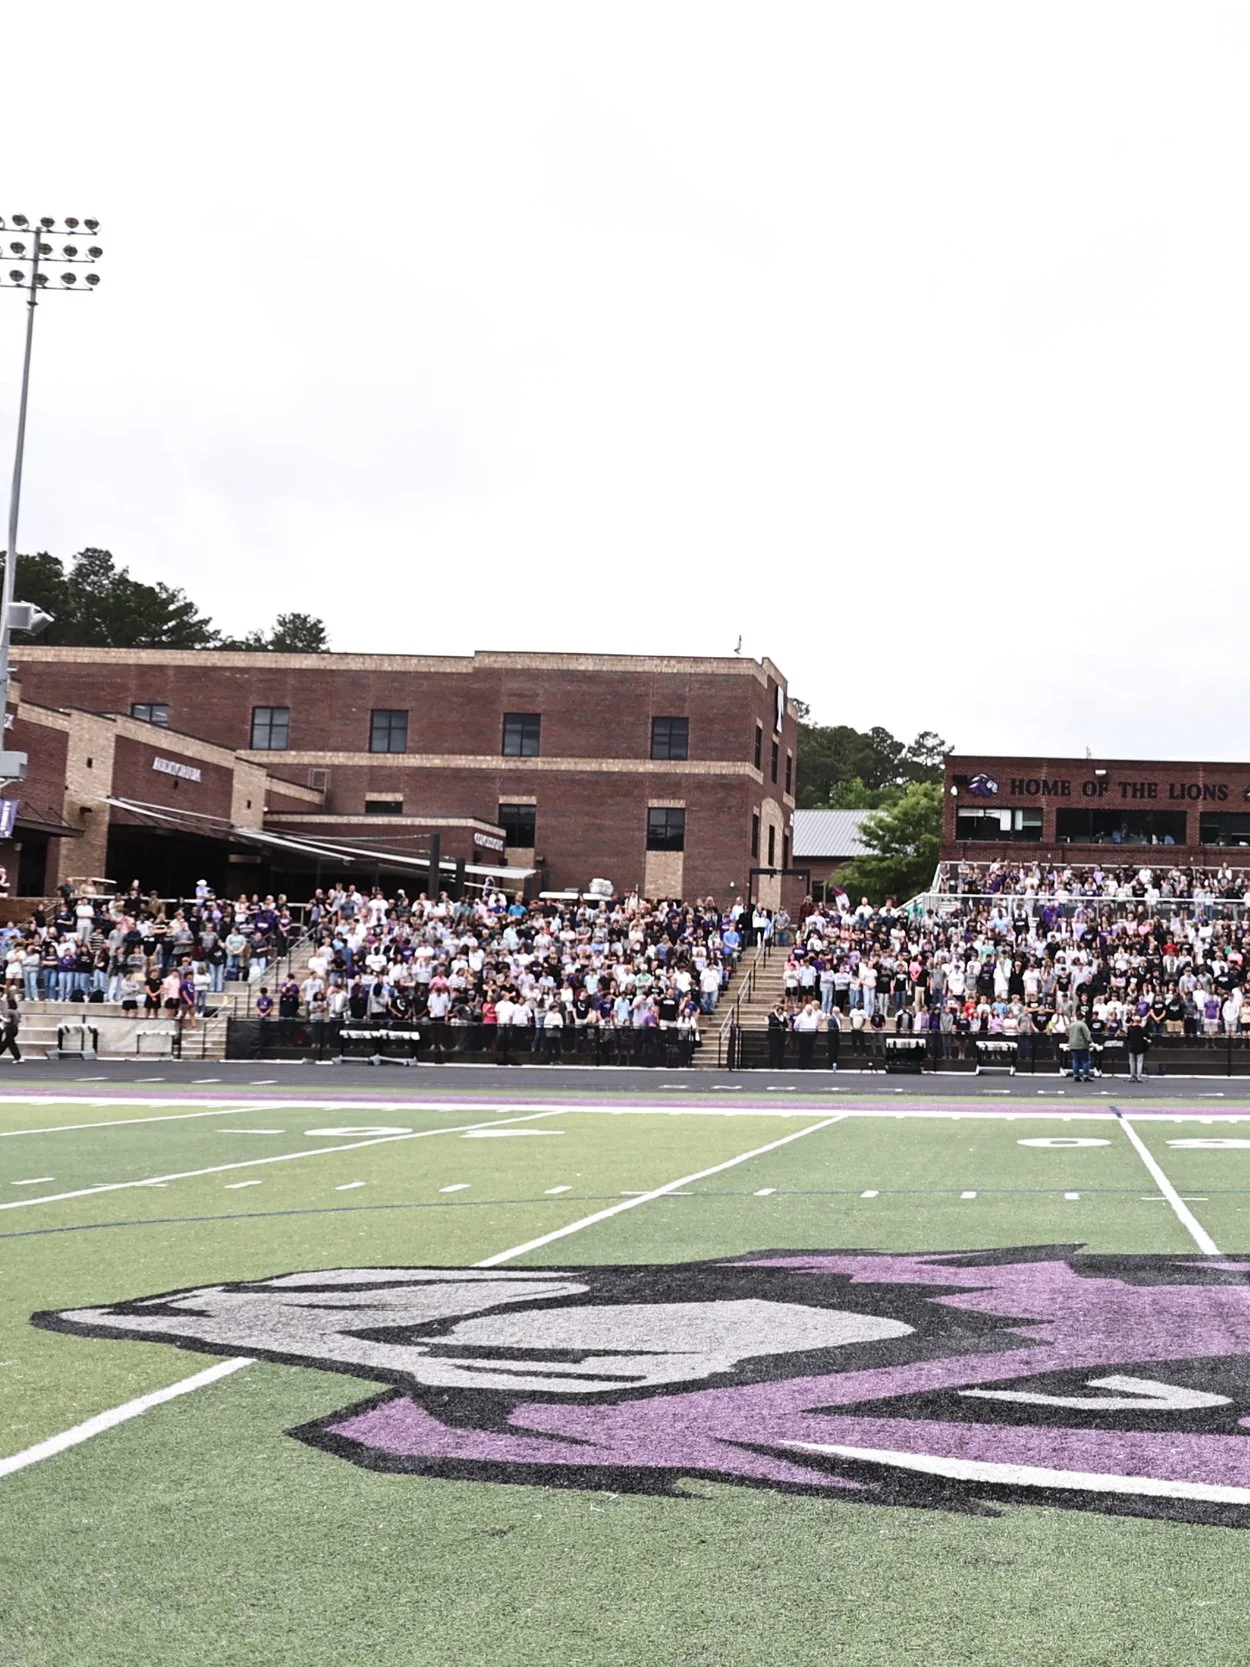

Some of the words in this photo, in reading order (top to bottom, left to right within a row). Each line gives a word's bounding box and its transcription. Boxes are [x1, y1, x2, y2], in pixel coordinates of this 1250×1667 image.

[1011, 779, 1071, 796] HOME
[1082, 781, 1109, 797] OF
[1118, 782, 1158, 799] THE
[1169, 783, 1228, 800] LIONS
